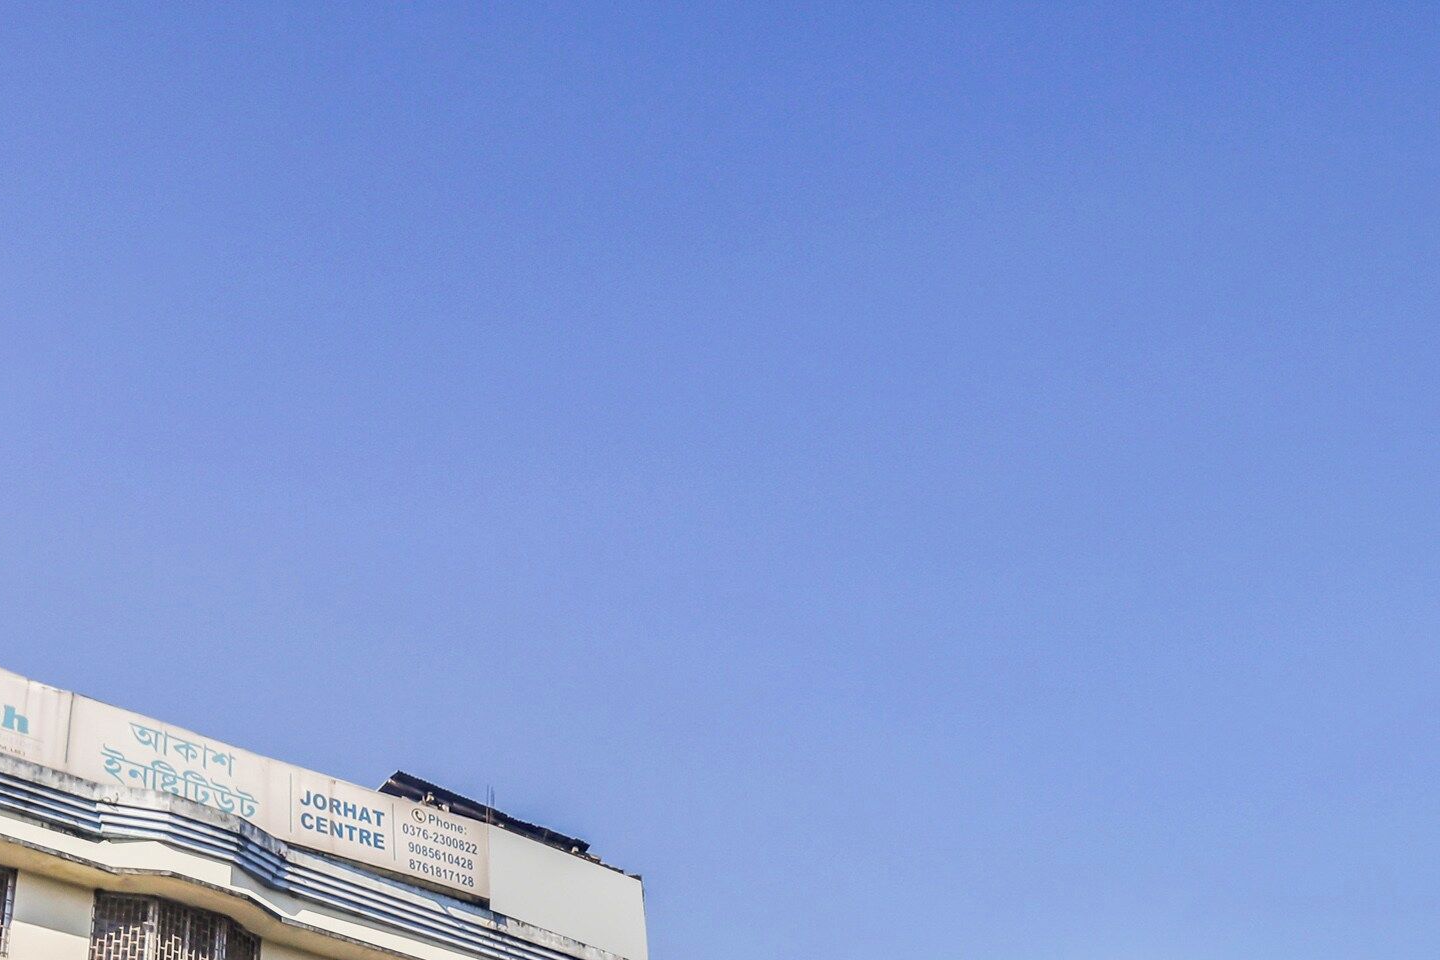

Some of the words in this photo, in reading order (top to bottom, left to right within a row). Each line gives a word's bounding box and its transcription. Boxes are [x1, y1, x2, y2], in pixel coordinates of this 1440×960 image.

[129, 722, 236, 777] আকাশ
[300, 790, 385, 827] JORHAT
[428, 813, 468, 836] Phone:
[300, 812, 385, 850] CENTRE
[402, 823, 478, 855] 0376-2300822
[408, 841, 474, 870] 9085610428
[409, 858, 475, 888] 8761817128
